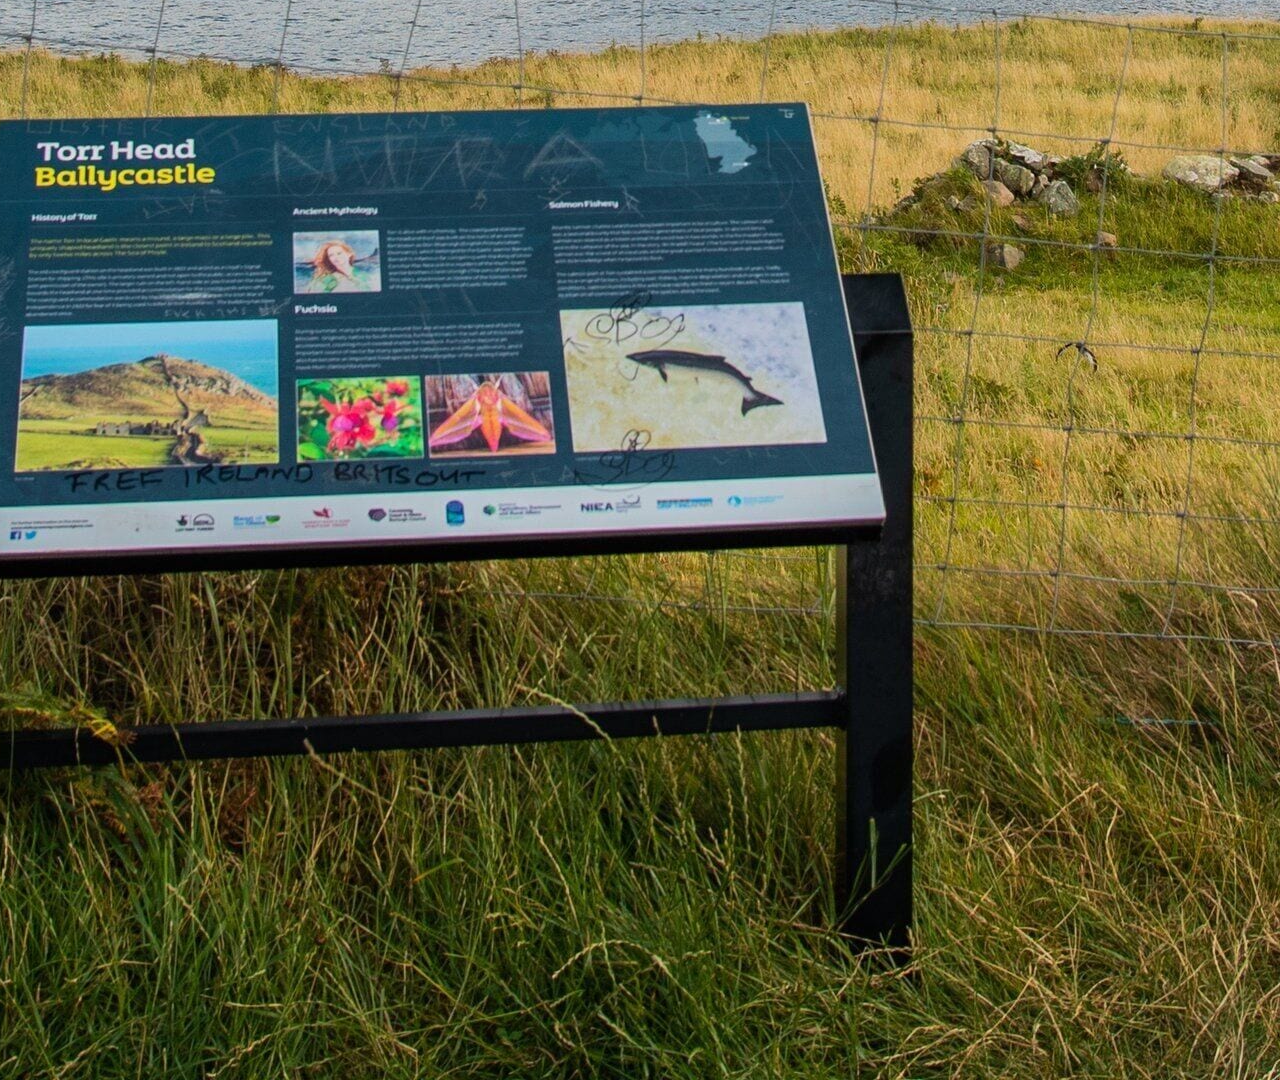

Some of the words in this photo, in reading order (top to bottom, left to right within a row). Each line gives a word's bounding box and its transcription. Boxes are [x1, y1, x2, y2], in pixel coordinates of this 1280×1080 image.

[36, 142, 105, 161] Torr
[110, 138, 197, 160] Head
[34, 163, 216, 191] Ballycastle
[548, 201, 584, 209] Salmon
[584, 199, 619, 209] Fishery
[292, 207, 328, 215] Ancient
[328, 206, 379, 216] Mythology
[31, 213, 67, 222] History
[67, 212, 77, 221] of
[77, 212, 98, 221] Torr
[294, 304, 338, 314] Fuchsia
[183, 463, 313, 488] IRELAND
[580, 502, 614, 513] NIEA
